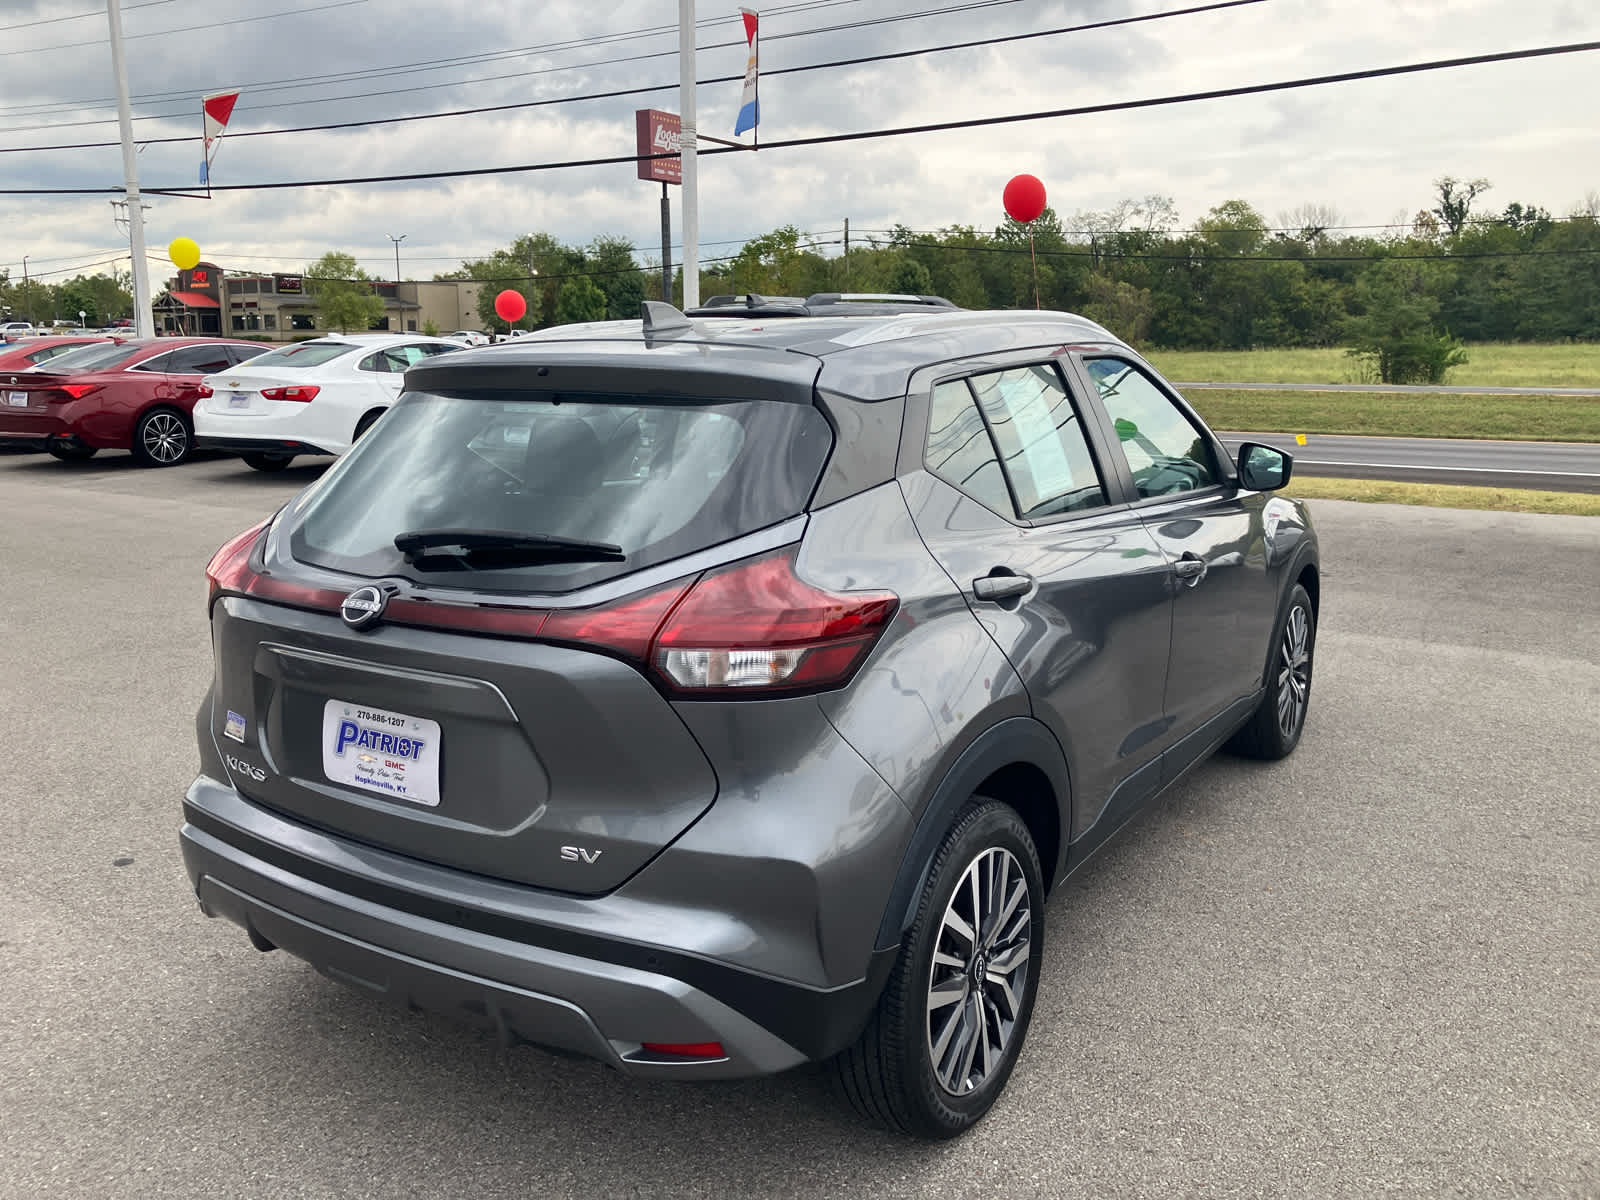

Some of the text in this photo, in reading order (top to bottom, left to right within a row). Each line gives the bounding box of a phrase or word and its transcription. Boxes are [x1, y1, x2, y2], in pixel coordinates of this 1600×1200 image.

[343, 599, 380, 611] ISSAN
[356, 710, 405, 728] 270-886-1207
[336, 719, 425, 760] PATRIOT
[226, 754, 266, 782] KICKS
[385, 760, 406, 771] GMC
[396, 785, 407, 793] KY
[560, 846, 602, 864] SV
